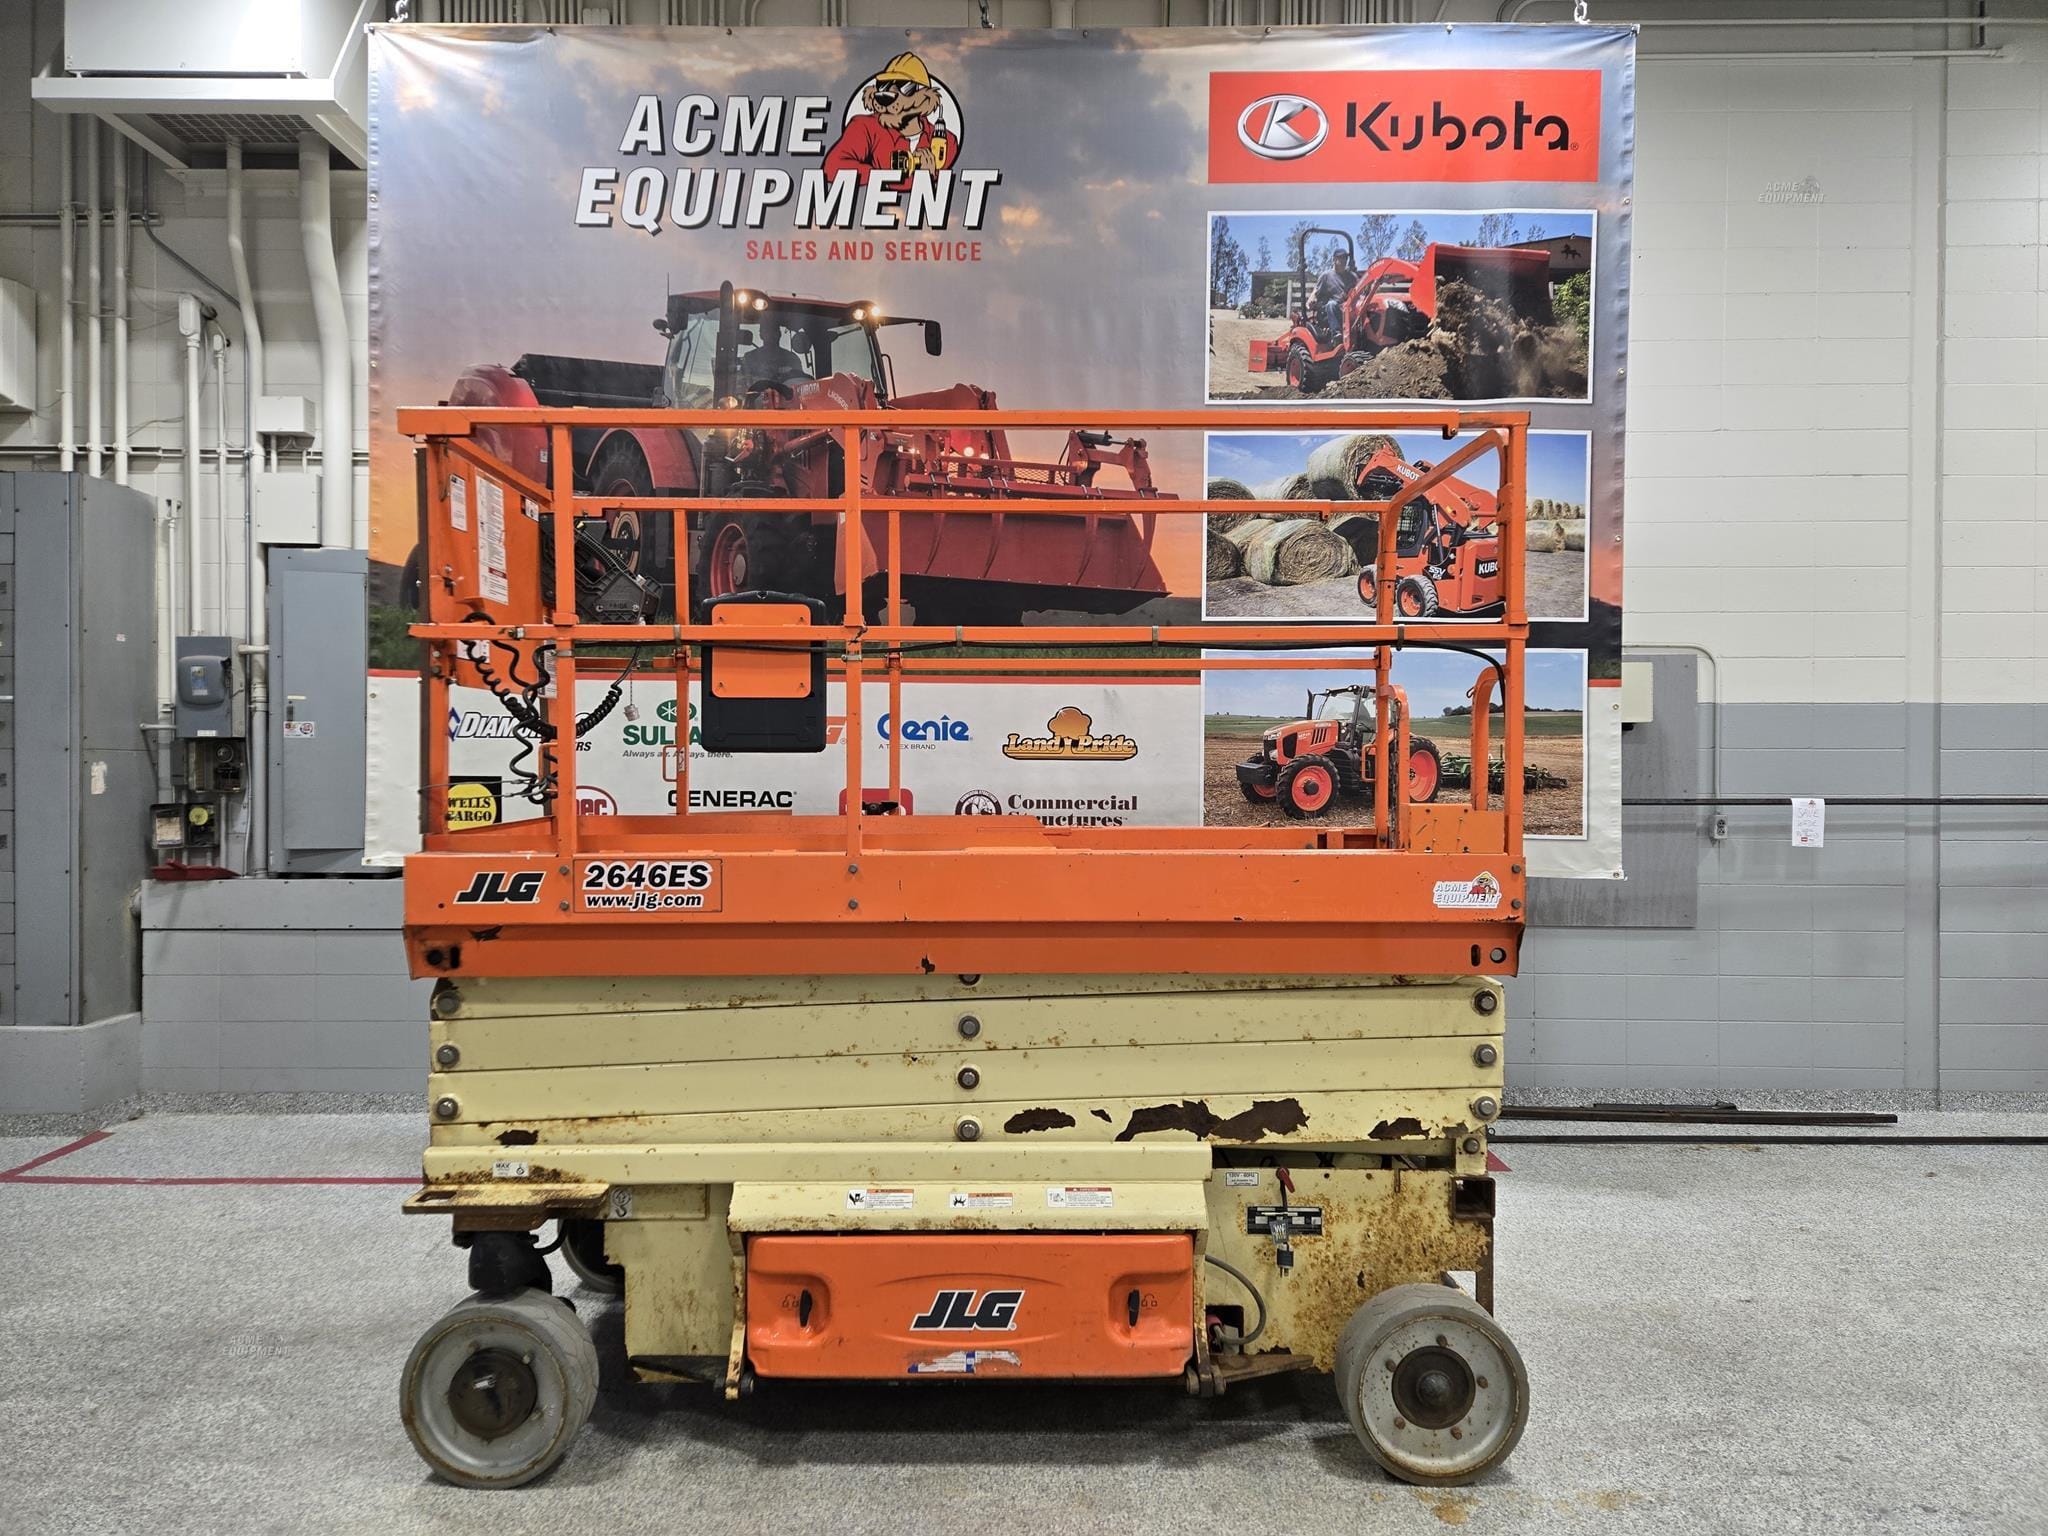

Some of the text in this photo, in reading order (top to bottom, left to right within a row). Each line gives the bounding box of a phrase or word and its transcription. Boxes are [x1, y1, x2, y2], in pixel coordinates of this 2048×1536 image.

[618, 94, 832, 158] ACME
[1346, 100, 1569, 151] Kubota
[574, 166, 1001, 235] EQUIPMENT
[746, 240, 982, 261] SALES AND SERVICE
[1429, 565, 1446, 575] SSV
[877, 713, 969, 741] Genie
[1008, 734, 1135, 753] Land Pride
[622, 750, 655, 759] Always
[668, 790, 793, 808] GENERAC
[1007, 794, 1138, 811] Commercial
[586, 863, 711, 888] 2646ES
[458, 873, 545, 902] JLG
[1435, 883, 1468, 893] ACME
[586, 893, 703, 911] www.jlg.com
[1435, 893, 1501, 904] EQUIPMENT
[913, 1291, 1024, 1330] JLG
